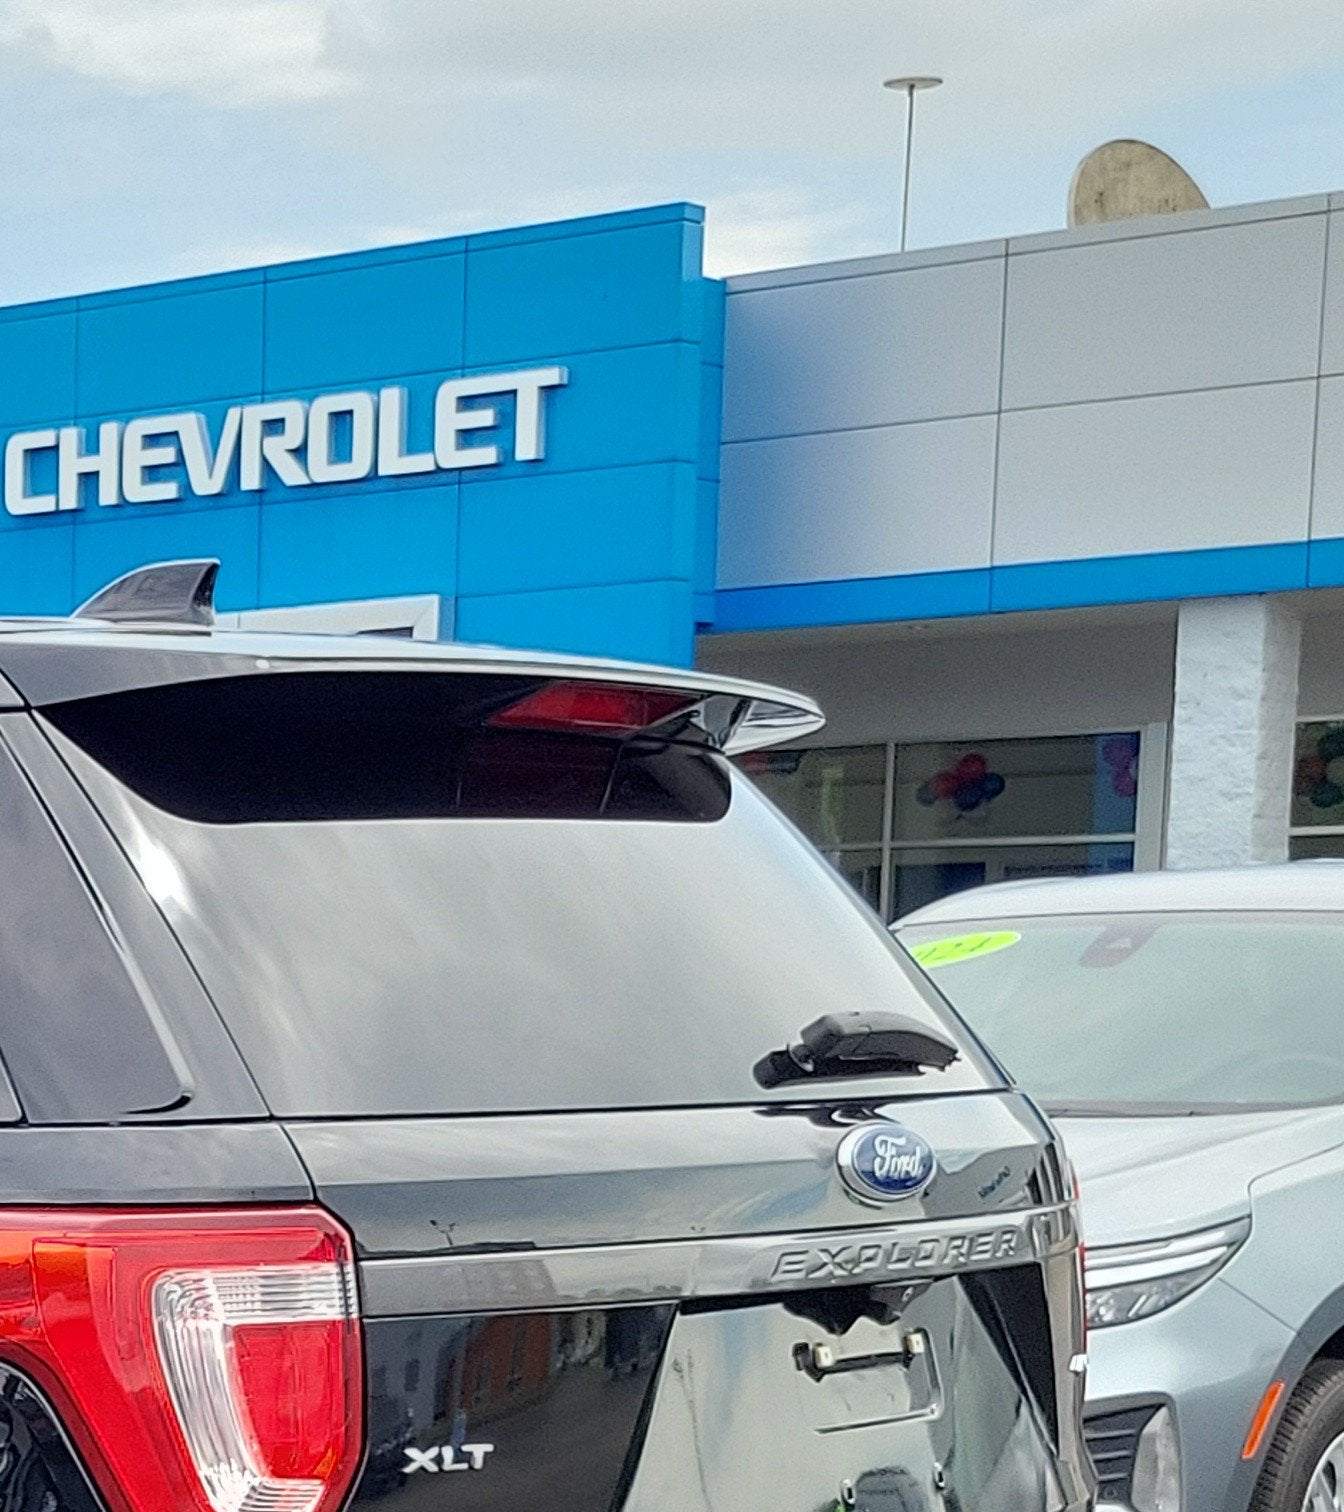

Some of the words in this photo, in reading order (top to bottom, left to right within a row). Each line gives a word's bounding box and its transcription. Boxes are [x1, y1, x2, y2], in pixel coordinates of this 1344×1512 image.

[4, 365, 569, 517] CHEVROLET
[873, 1134, 924, 1180] Ford
[770, 1230, 1018, 1283] EXPLORER
[402, 1442, 495, 1474] XLT
